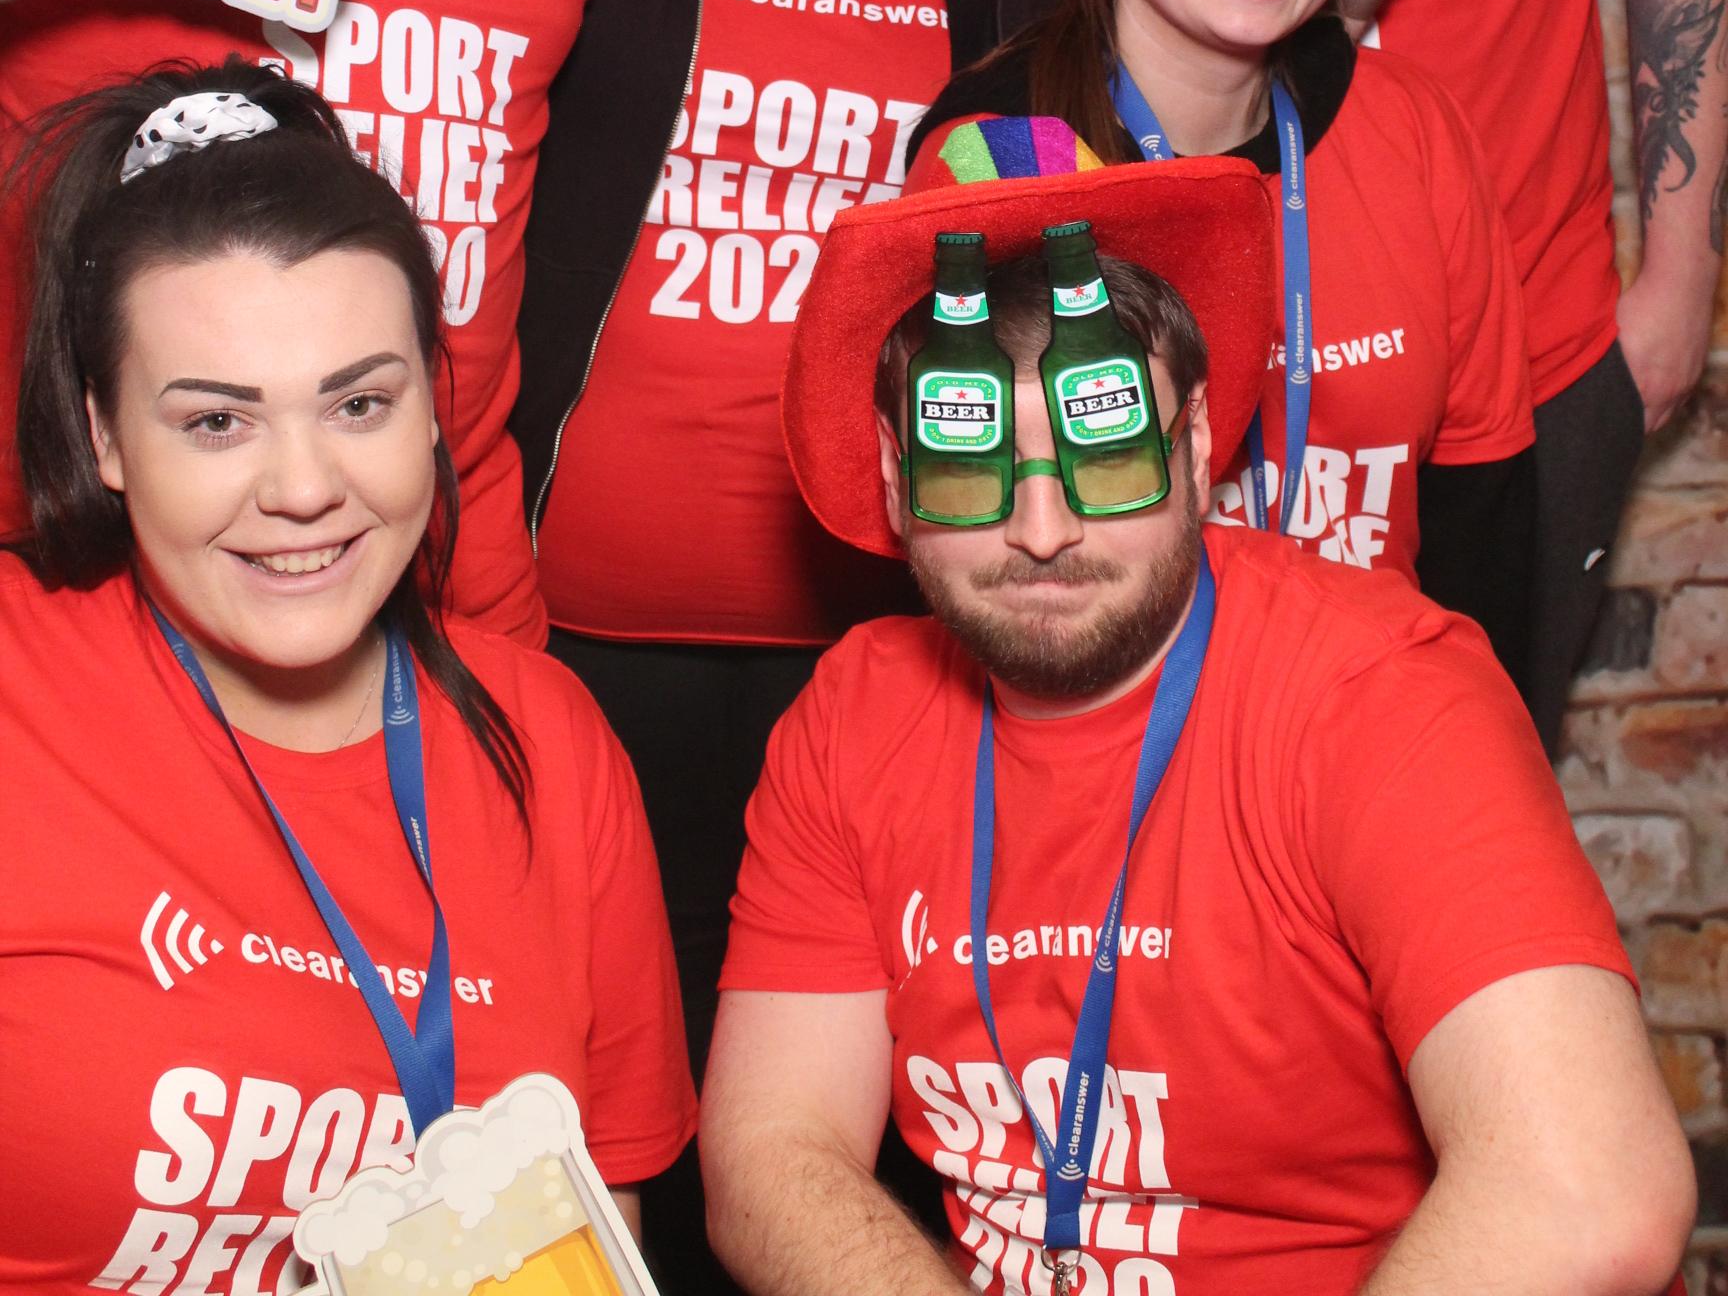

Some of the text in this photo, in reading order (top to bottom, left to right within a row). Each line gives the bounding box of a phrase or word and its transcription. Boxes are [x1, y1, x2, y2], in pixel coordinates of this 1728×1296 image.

[649, 228, 820, 324] 202
[1065, 293, 1092, 304] BEER
[946, 305, 975, 313] BEER
[1295, 292, 1304, 363] clearanswer
[924, 403, 990, 420] BEER
[1068, 390, 1134, 416] BEER
[1068, 1071, 1090, 1156] clearanswer
[134, 1066, 416, 1211] SPOR
